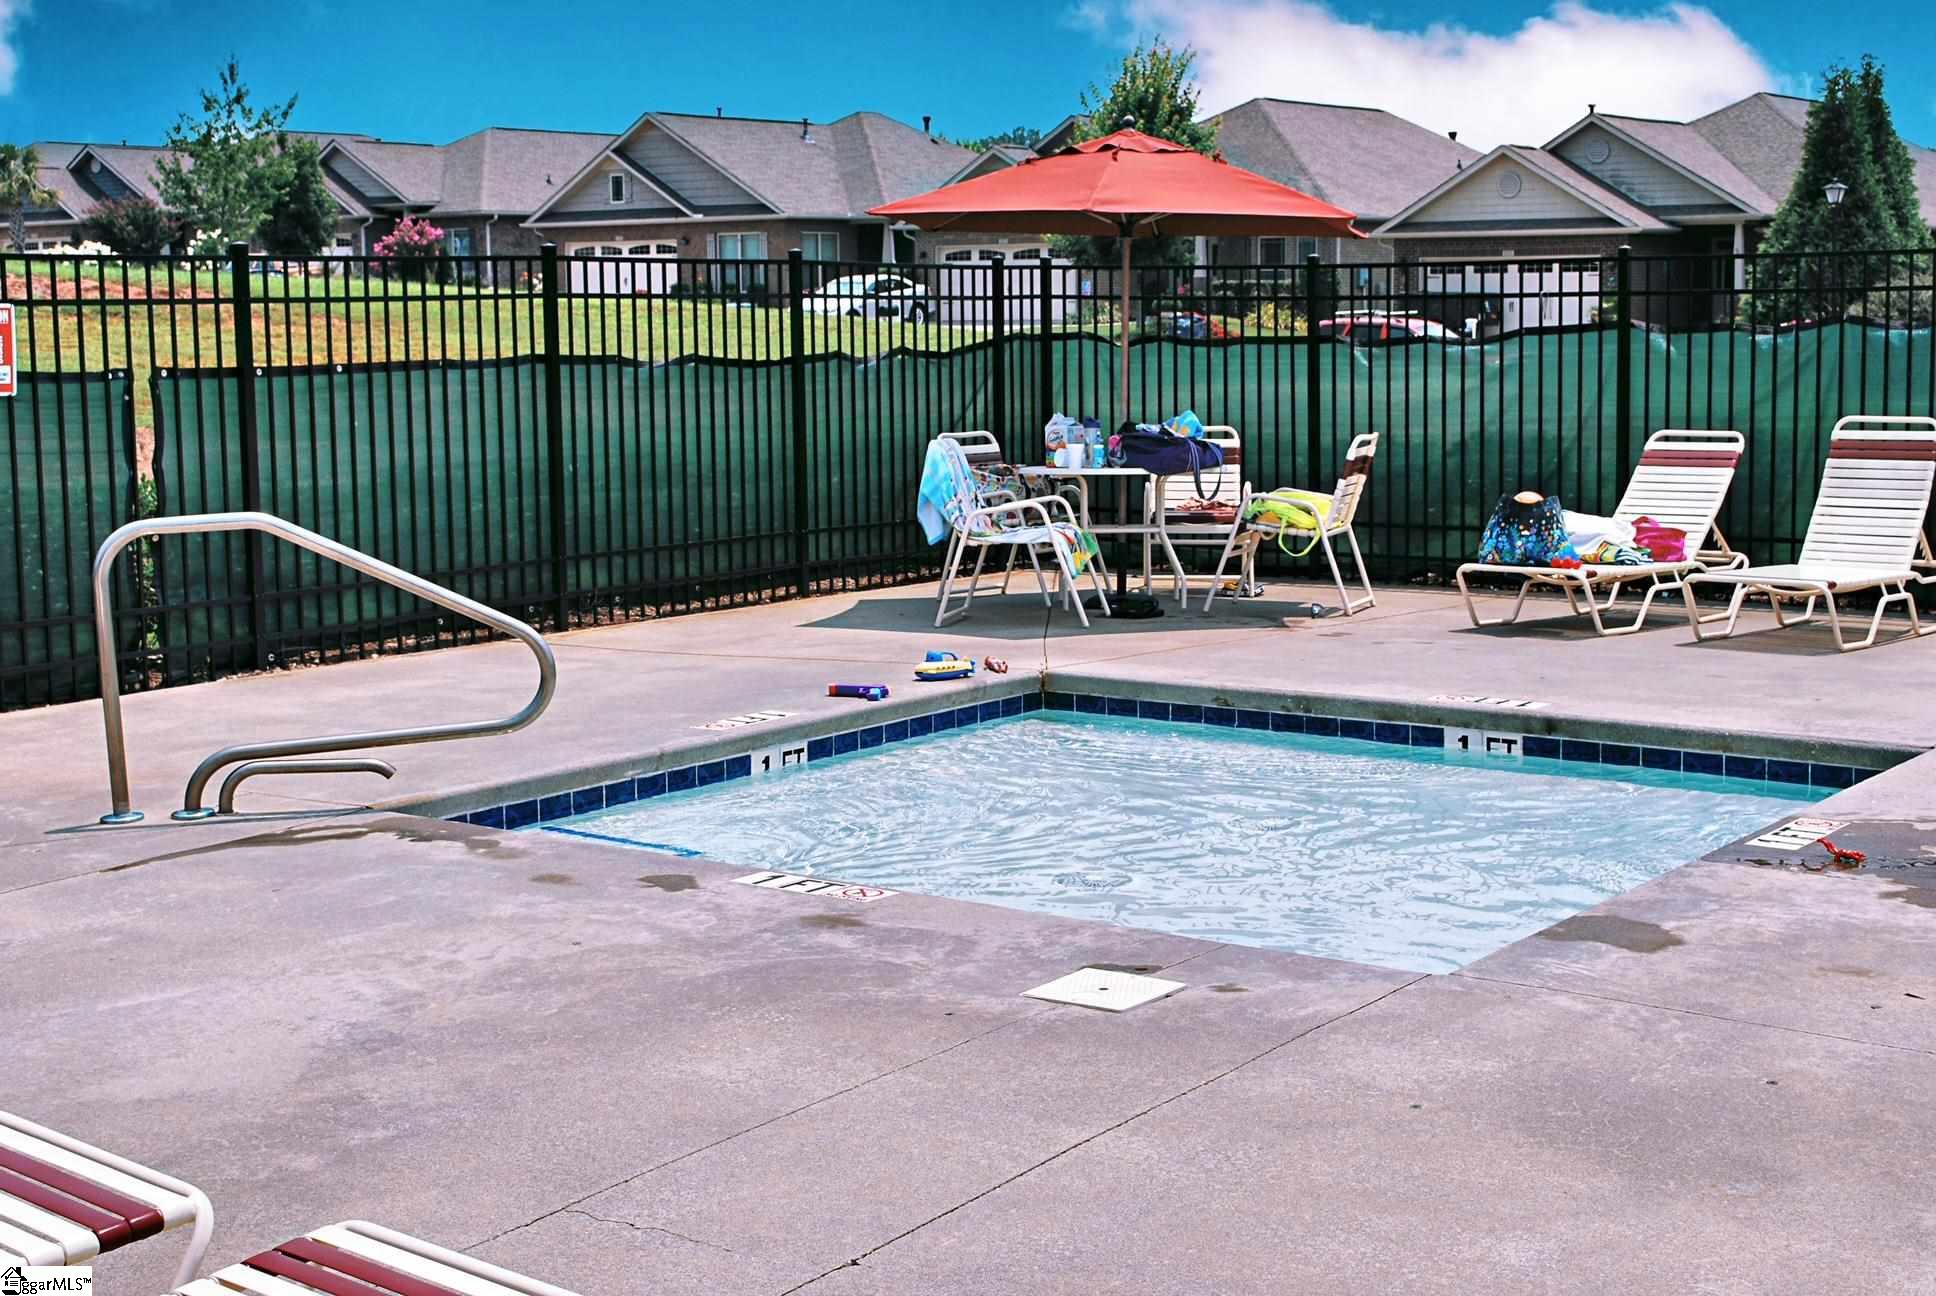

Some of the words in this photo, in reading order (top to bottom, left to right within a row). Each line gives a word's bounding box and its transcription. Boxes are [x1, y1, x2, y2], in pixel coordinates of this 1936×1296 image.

[1457, 734, 1470, 751] 1
[1486, 736, 1518, 754] FT
[761, 754, 771, 772] 1
[782, 747, 805, 767] FT
[751, 874, 785, 885] 1
[779, 879, 846, 893] FT
